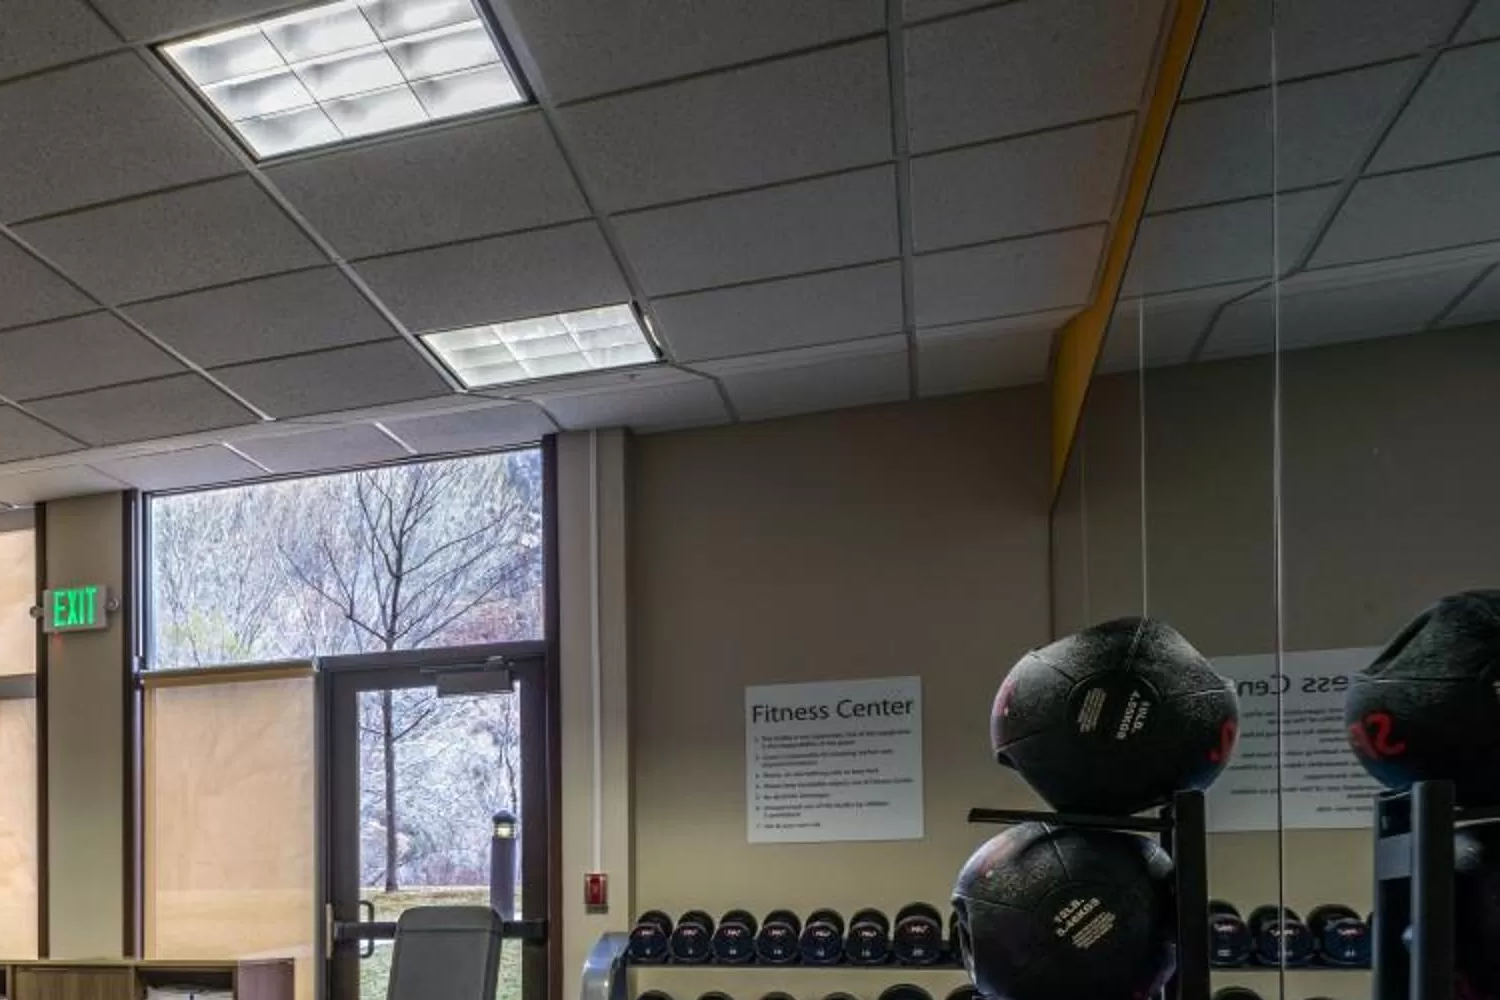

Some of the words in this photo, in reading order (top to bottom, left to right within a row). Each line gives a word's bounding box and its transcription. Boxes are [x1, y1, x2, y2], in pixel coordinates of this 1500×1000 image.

[53, 587, 97, 627] EXIT
[752, 704, 830, 724] Fitness
[835, 699, 914, 719] Center
